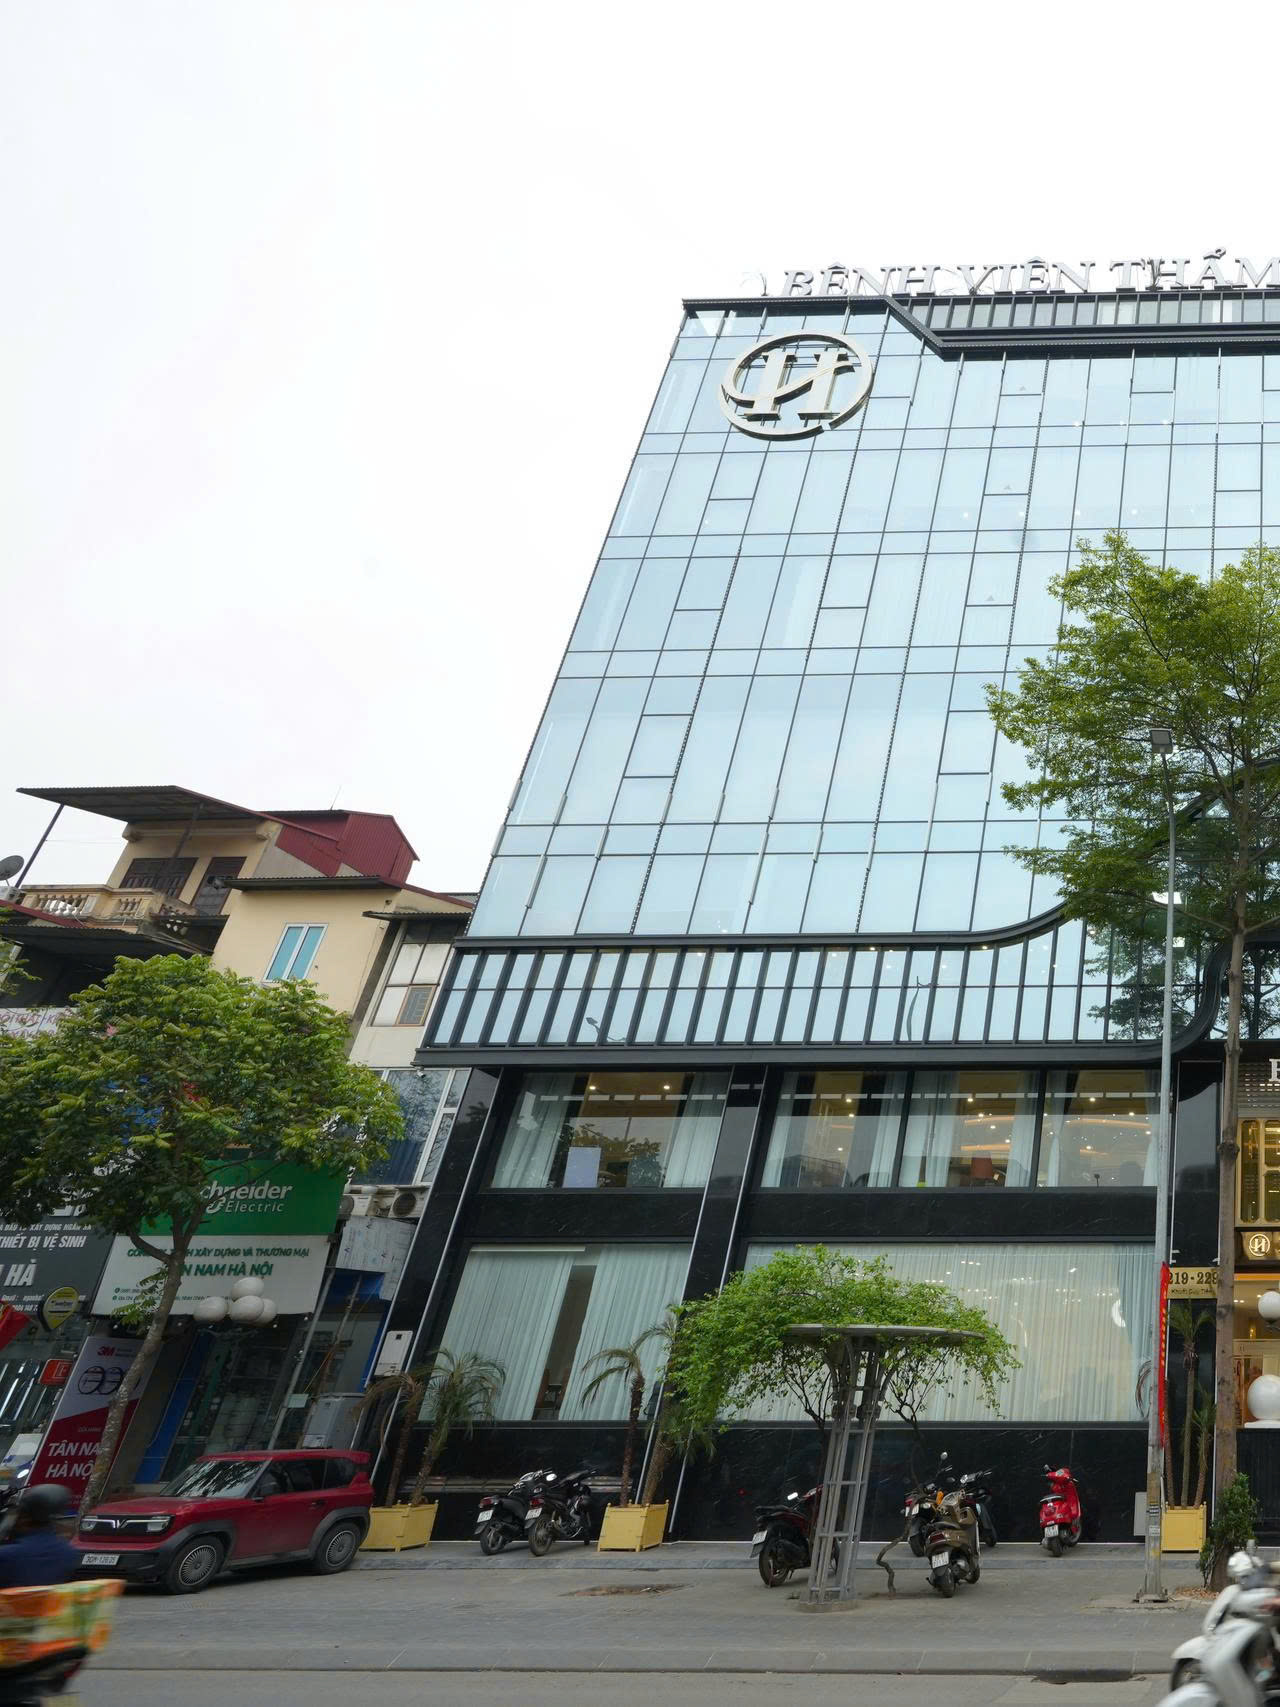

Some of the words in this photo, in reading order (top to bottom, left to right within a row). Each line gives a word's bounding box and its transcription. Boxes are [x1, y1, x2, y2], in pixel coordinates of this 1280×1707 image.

[199, 1180, 293, 1199] chneider
[225, 1200, 285, 1213] Electric
[27, 1236, 42, 1251] BỊ
[42, 1233, 59, 1251] VỆ
[58, 1236, 87, 1248] SINH
[194, 1263, 227, 1276] NAM
[228, 1262, 246, 1276] HÀ
[249, 1261, 274, 1279] NỘI
[48, 1439, 78, 1457] TÂN
[78, 1441, 103, 1457] NA
[45, 1460, 69, 1478] HÀ
[69, 1459, 95, 1480] NỘ
